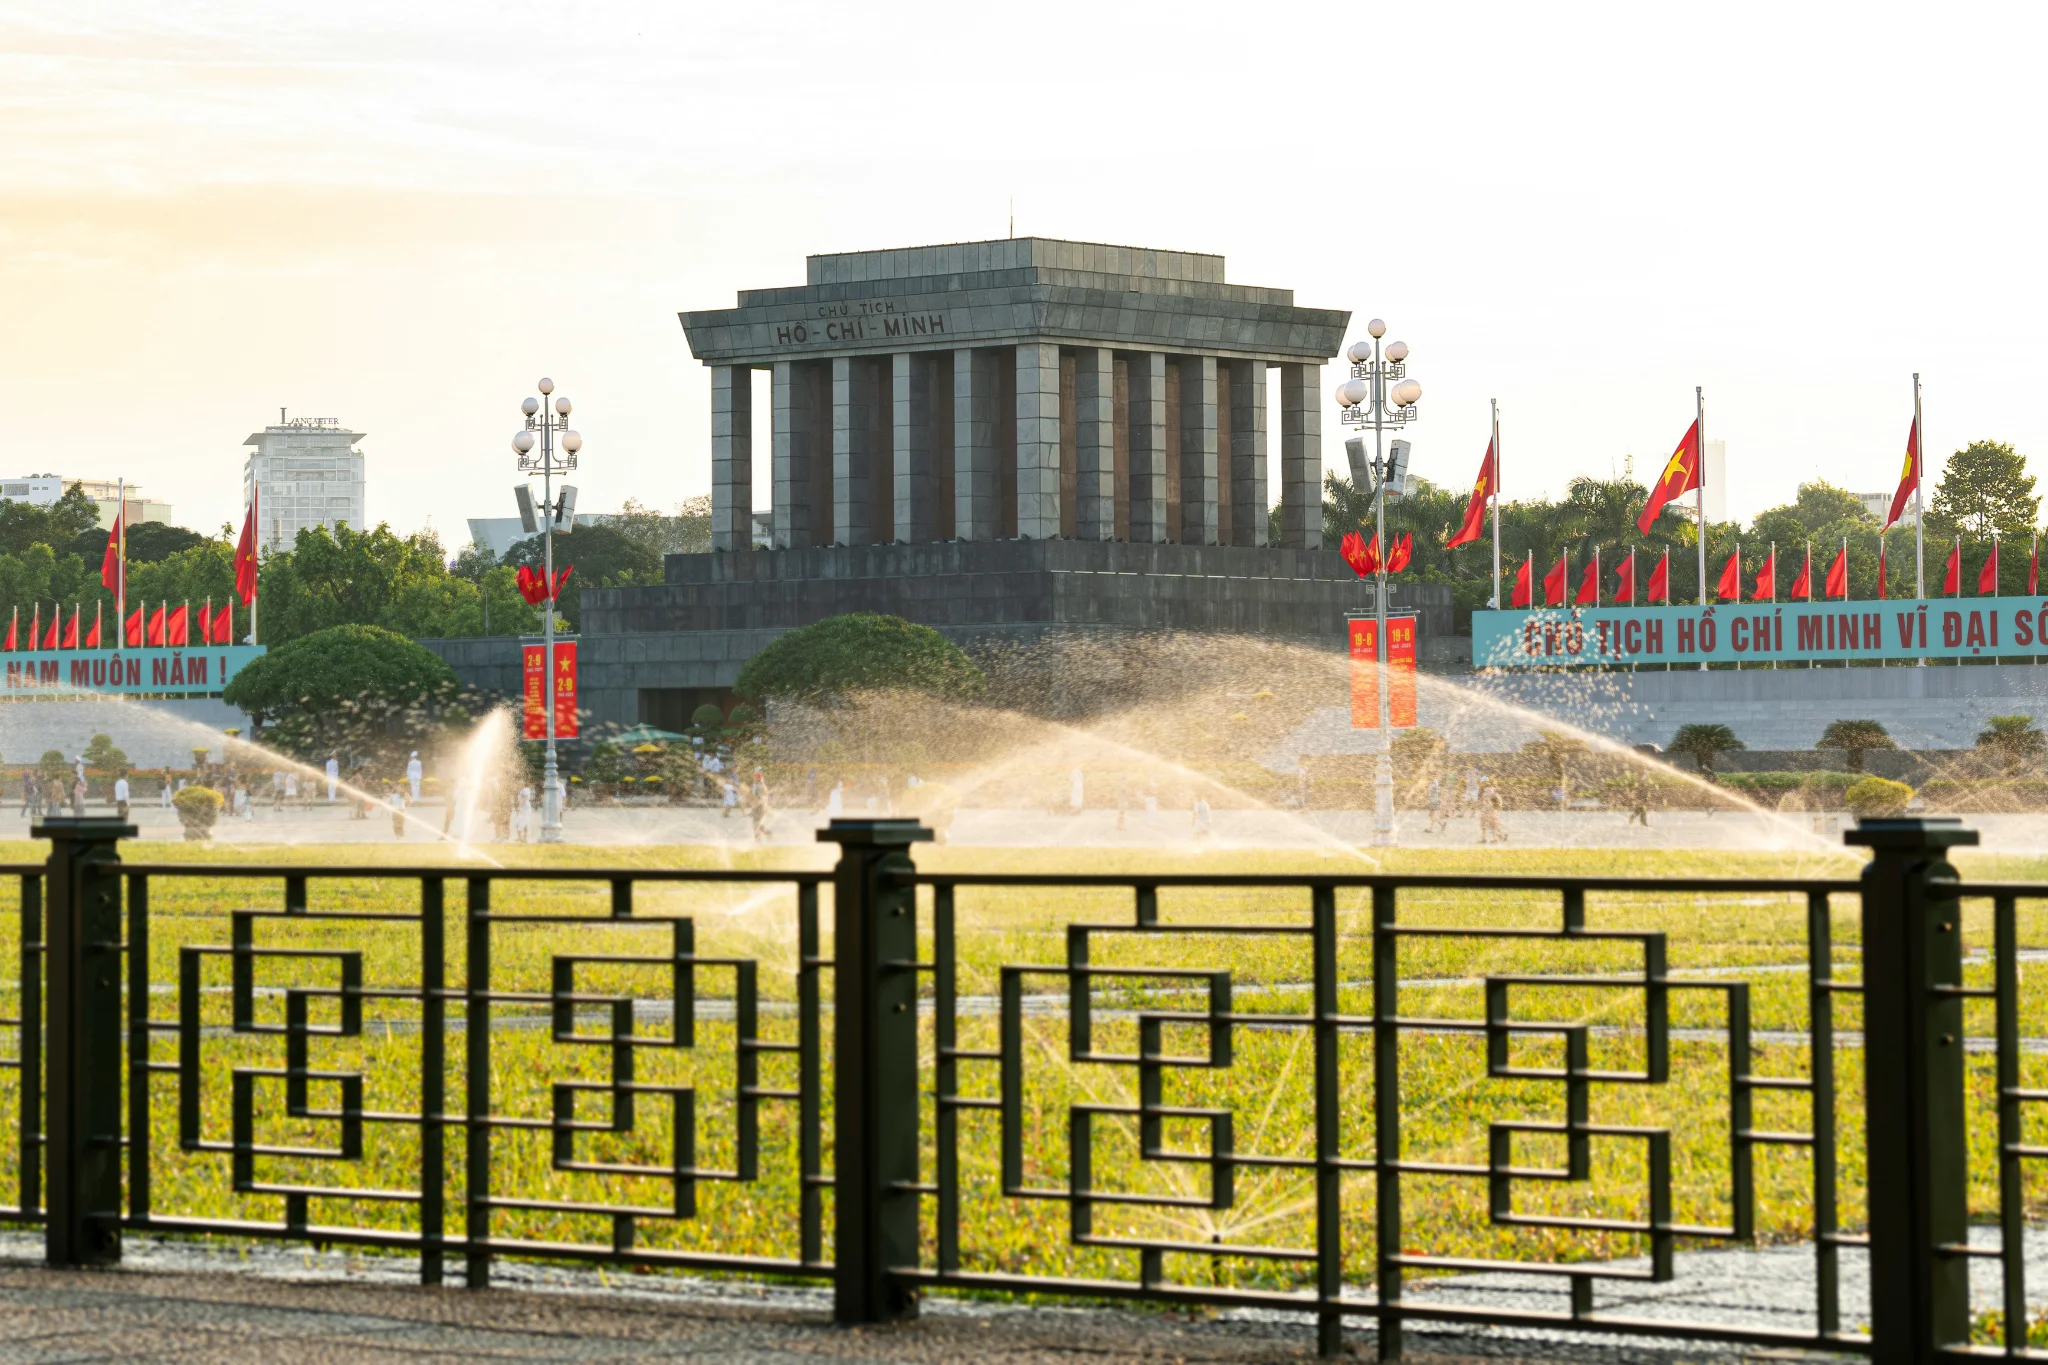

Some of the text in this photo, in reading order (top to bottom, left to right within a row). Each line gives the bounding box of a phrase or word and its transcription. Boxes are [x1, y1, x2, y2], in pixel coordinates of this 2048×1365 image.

[1524, 609, 1583, 656] CHỦ
[1596, 618, 1663, 661] TỊCH
[1677, 606, 1716, 653] HỒ
[1731, 608, 1783, 652] CHÍ
[1797, 613, 1882, 650] MINH
[1897, 604, 1928, 649] VĨ
[1942, 609, 1998, 654] ĐẠI
[7, 660, 59, 688] NAM
[70, 653, 141, 687] MUÔN
[152, 651, 207, 686] NĂM
[528, 654, 541, 666] 2-9
[557, 677, 573, 691] 2-9
